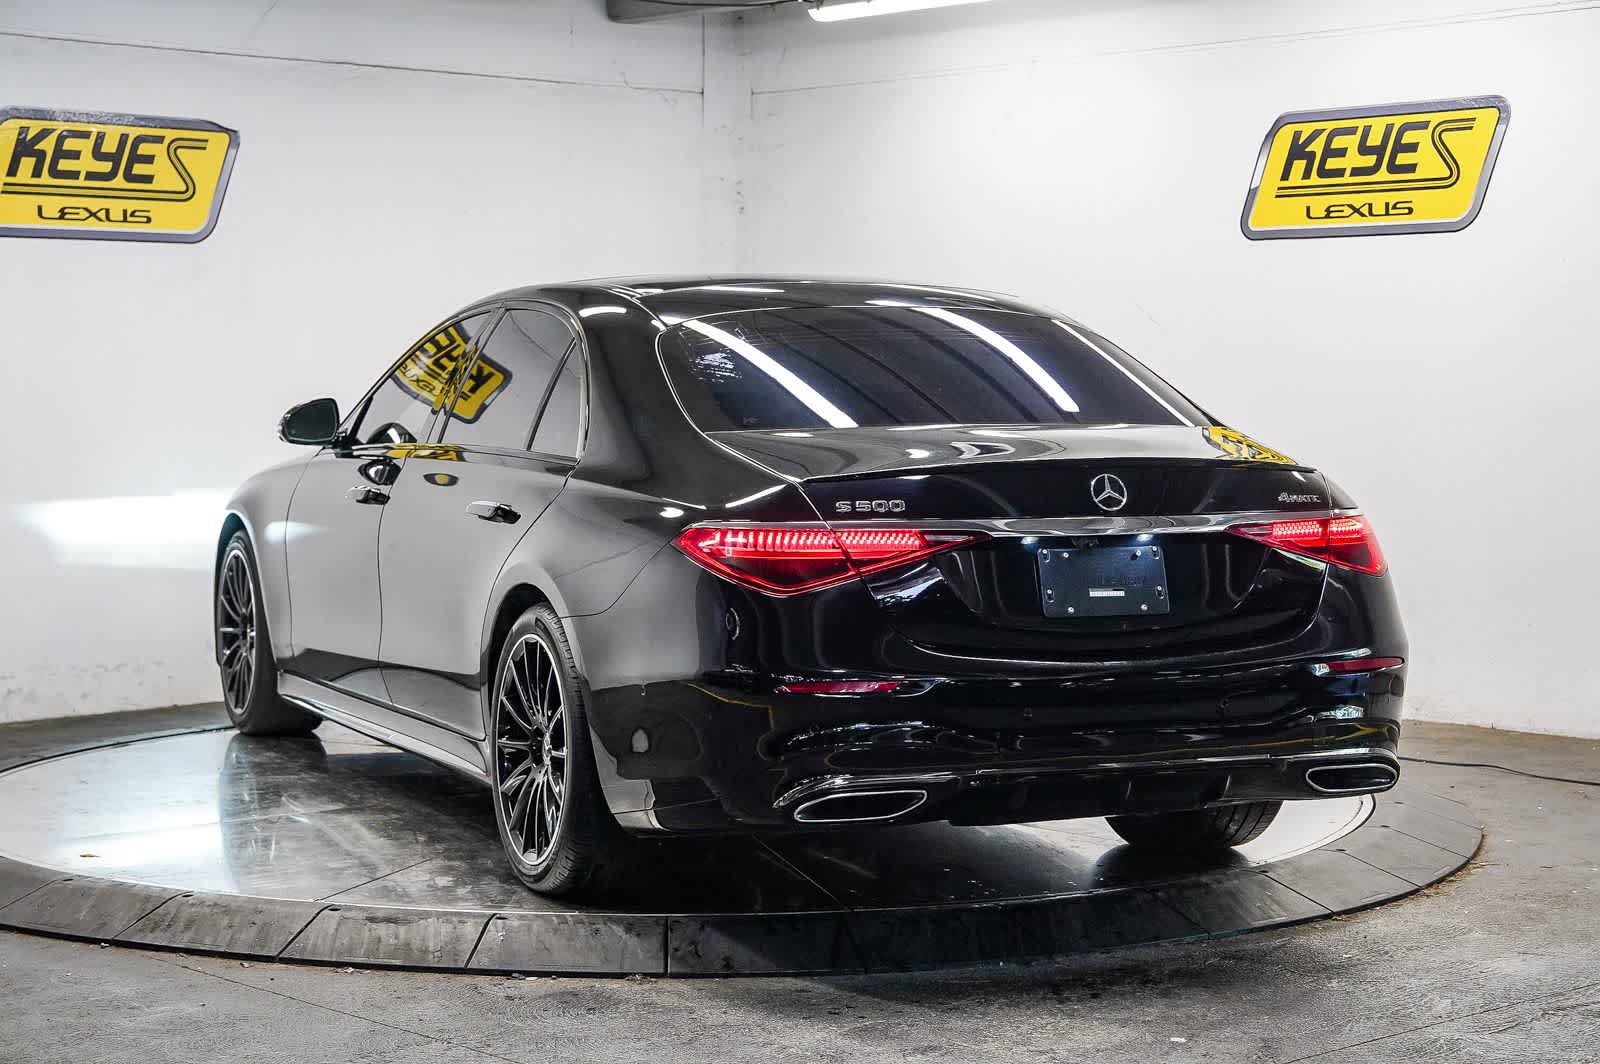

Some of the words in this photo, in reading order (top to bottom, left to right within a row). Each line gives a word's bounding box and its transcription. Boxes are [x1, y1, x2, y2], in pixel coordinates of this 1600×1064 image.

[3, 126, 209, 202] KEYES
[1276, 117, 1477, 198] KEYES
[37, 205, 152, 224] LEXUS
[1305, 200, 1413, 220] LEXUS
[836, 501, 852, 512] S
[855, 499, 906, 513] 500
